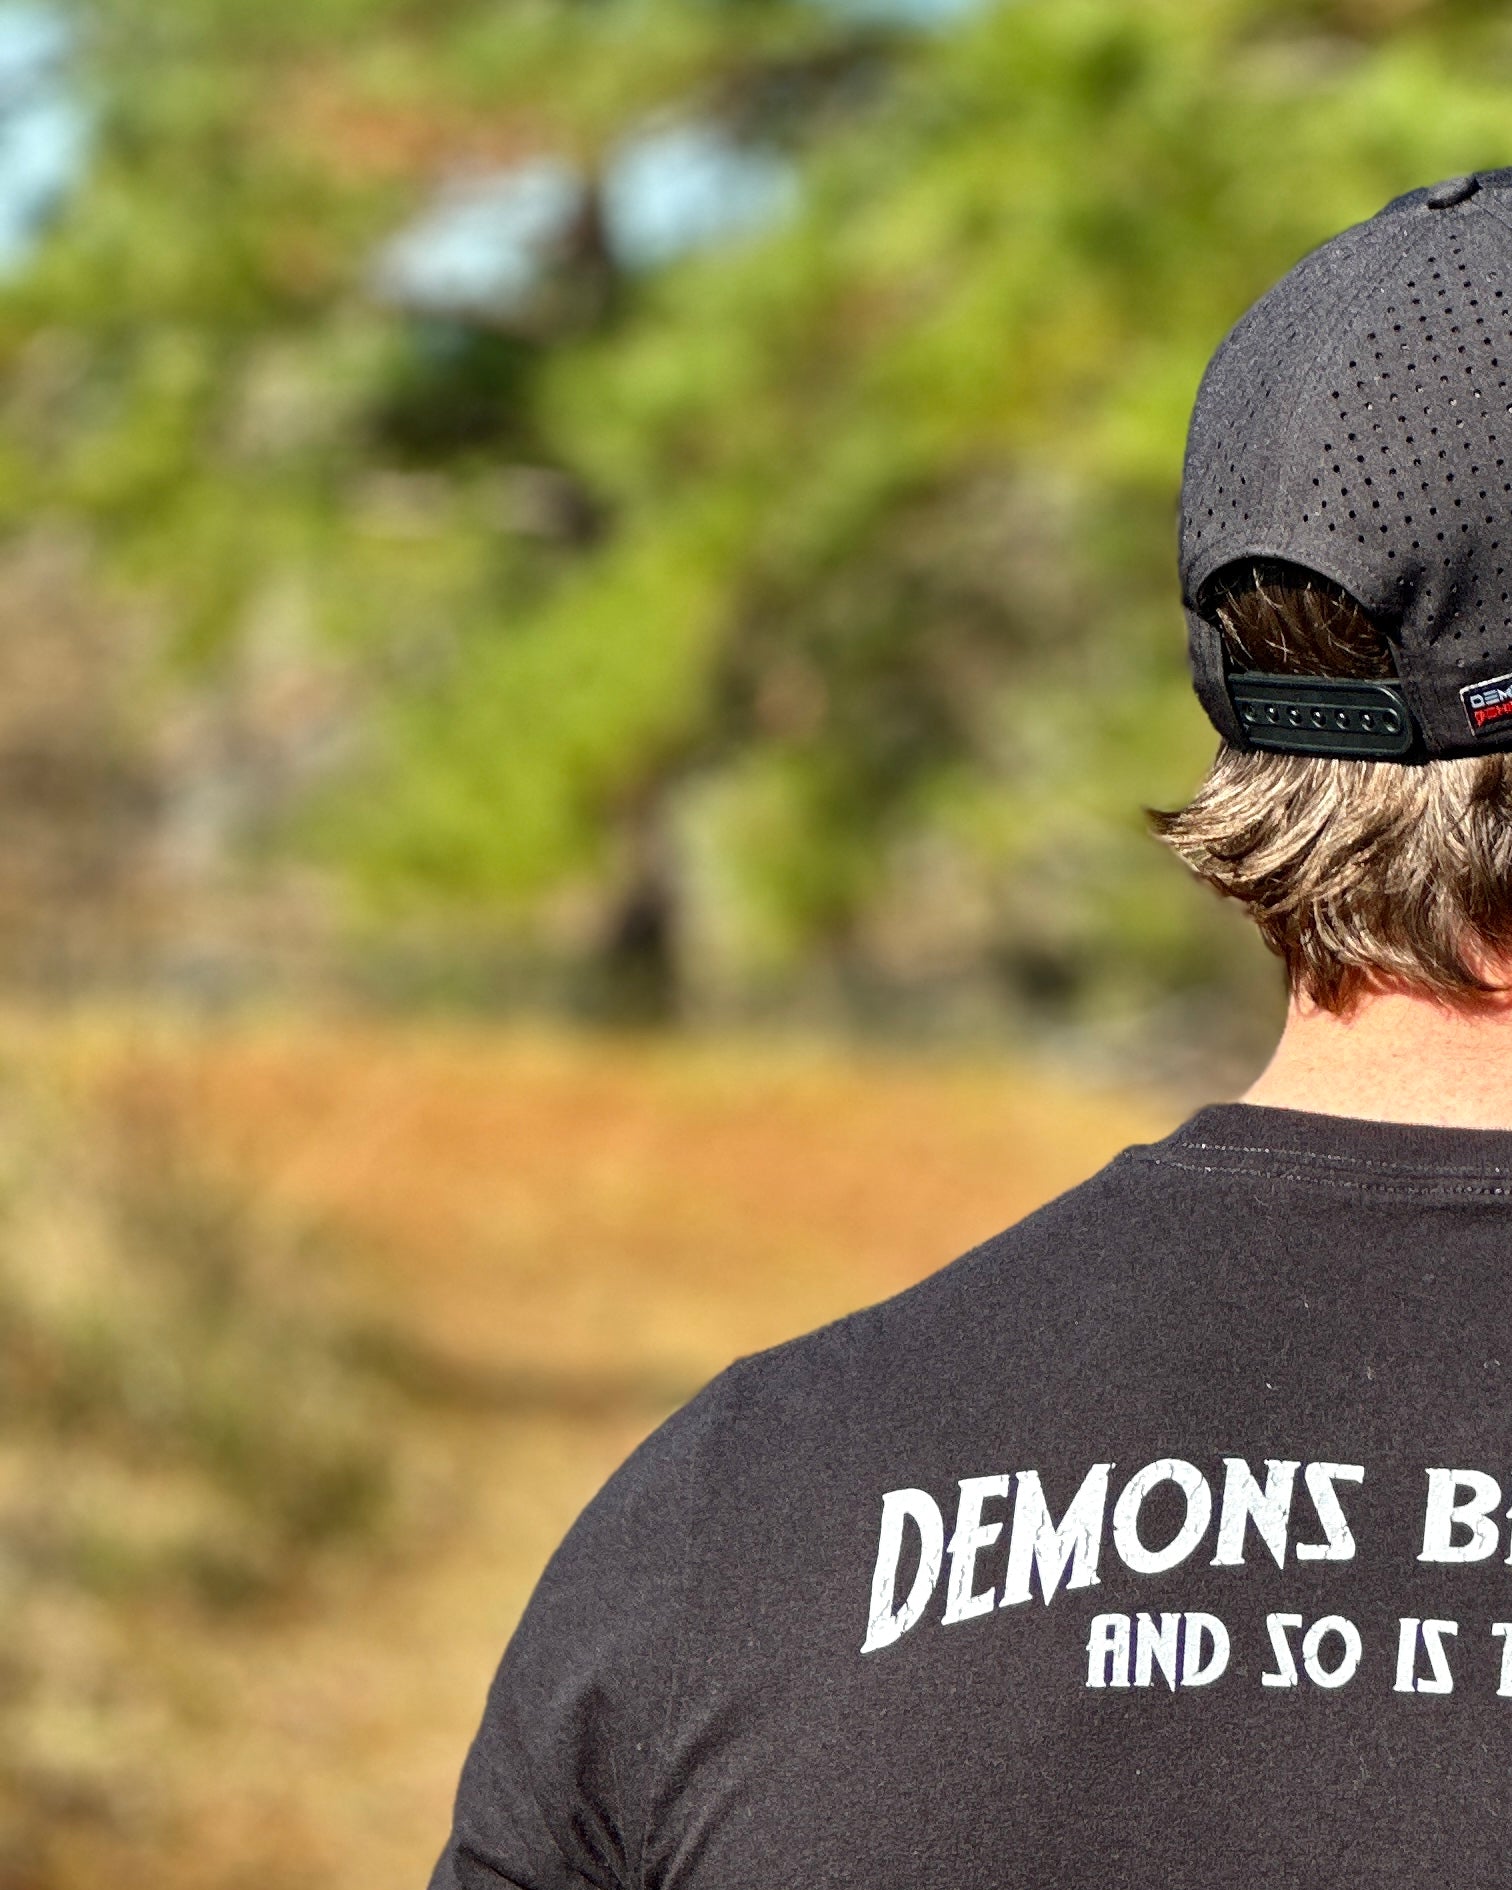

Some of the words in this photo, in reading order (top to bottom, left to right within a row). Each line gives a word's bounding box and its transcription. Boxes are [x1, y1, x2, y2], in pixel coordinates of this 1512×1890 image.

[860, 1458, 1364, 1654] DEMONS
[1086, 1612, 1230, 1692] AND
[1262, 1613, 1362, 1688] SO
[1393, 1618, 1458, 1694] IS
